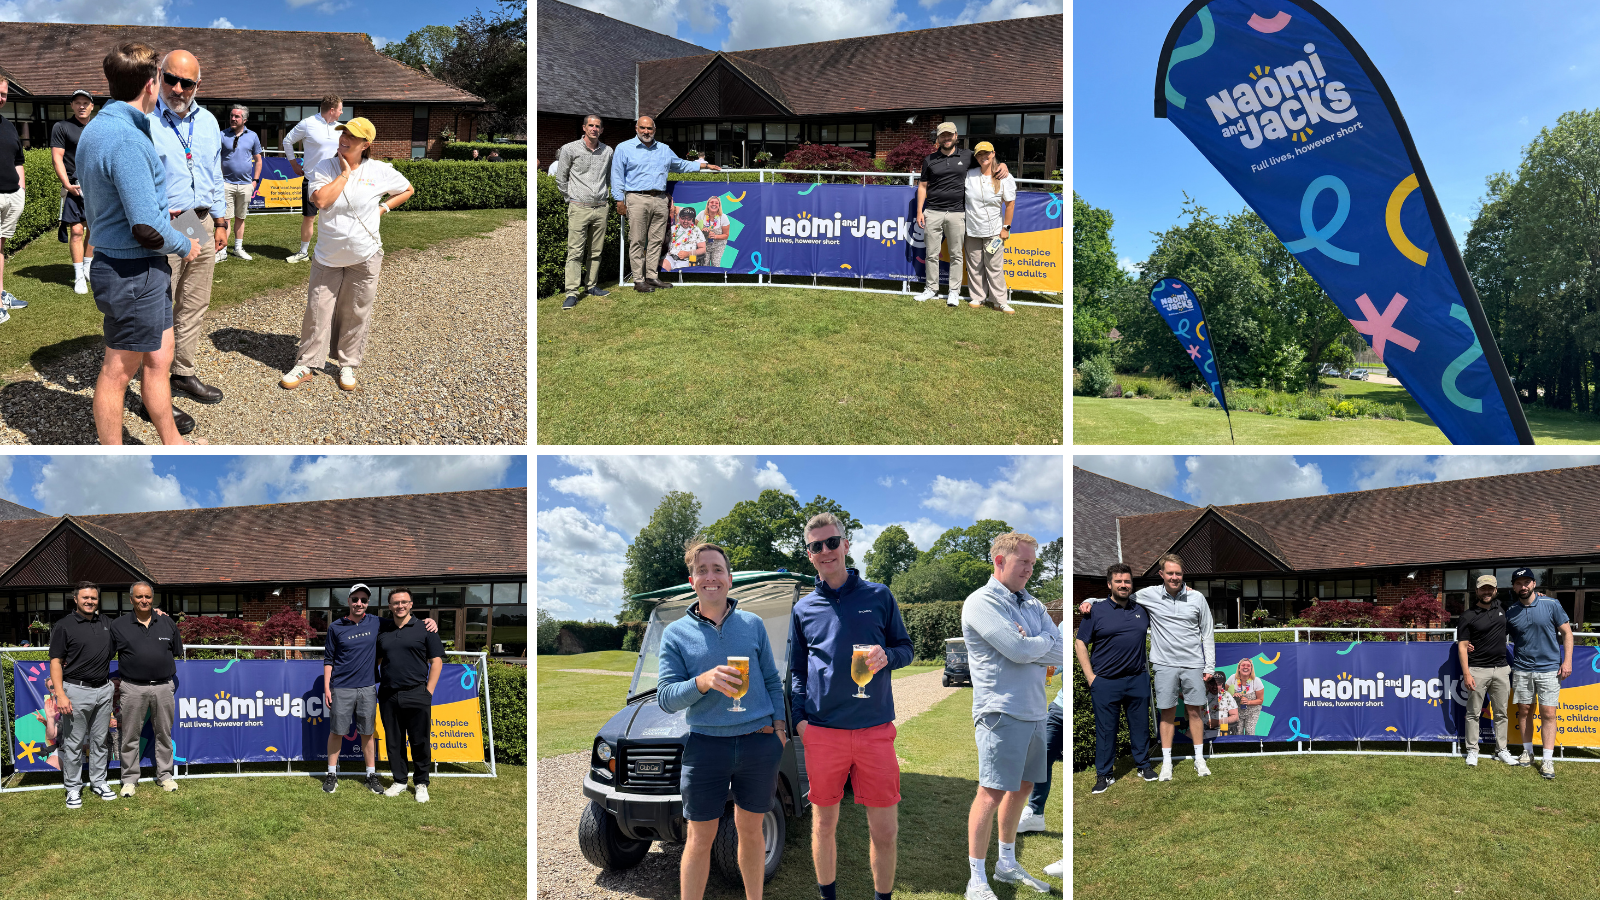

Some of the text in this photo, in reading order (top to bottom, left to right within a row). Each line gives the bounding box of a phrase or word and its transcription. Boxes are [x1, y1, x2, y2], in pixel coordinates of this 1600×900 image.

[1206, 43, 1327, 126] Naomi
[1221, 79, 1358, 149] and Jack's
[1251, 121, 1364, 173] Full lives, however short
[765, 212, 842, 238] Naomi
[842, 218, 858, 227] and
[1014, 246, 1051, 256] hospice
[1017, 258, 1056, 267] children
[1017, 269, 1047, 278] adults
[1160, 291, 1189, 305] Naomi
[1303, 671, 1384, 700] Naomi
[1385, 678, 1402, 687] and
[179, 690, 264, 720] Naomi
[264, 697, 281, 706] and
[1563, 702, 1599, 712] hospice
[213, 720, 243, 728] however
[435, 718, 469, 729] hospice
[439, 729, 475, 738] children
[1566, 724, 1597, 734] adults
[440, 740, 468, 749] adults
